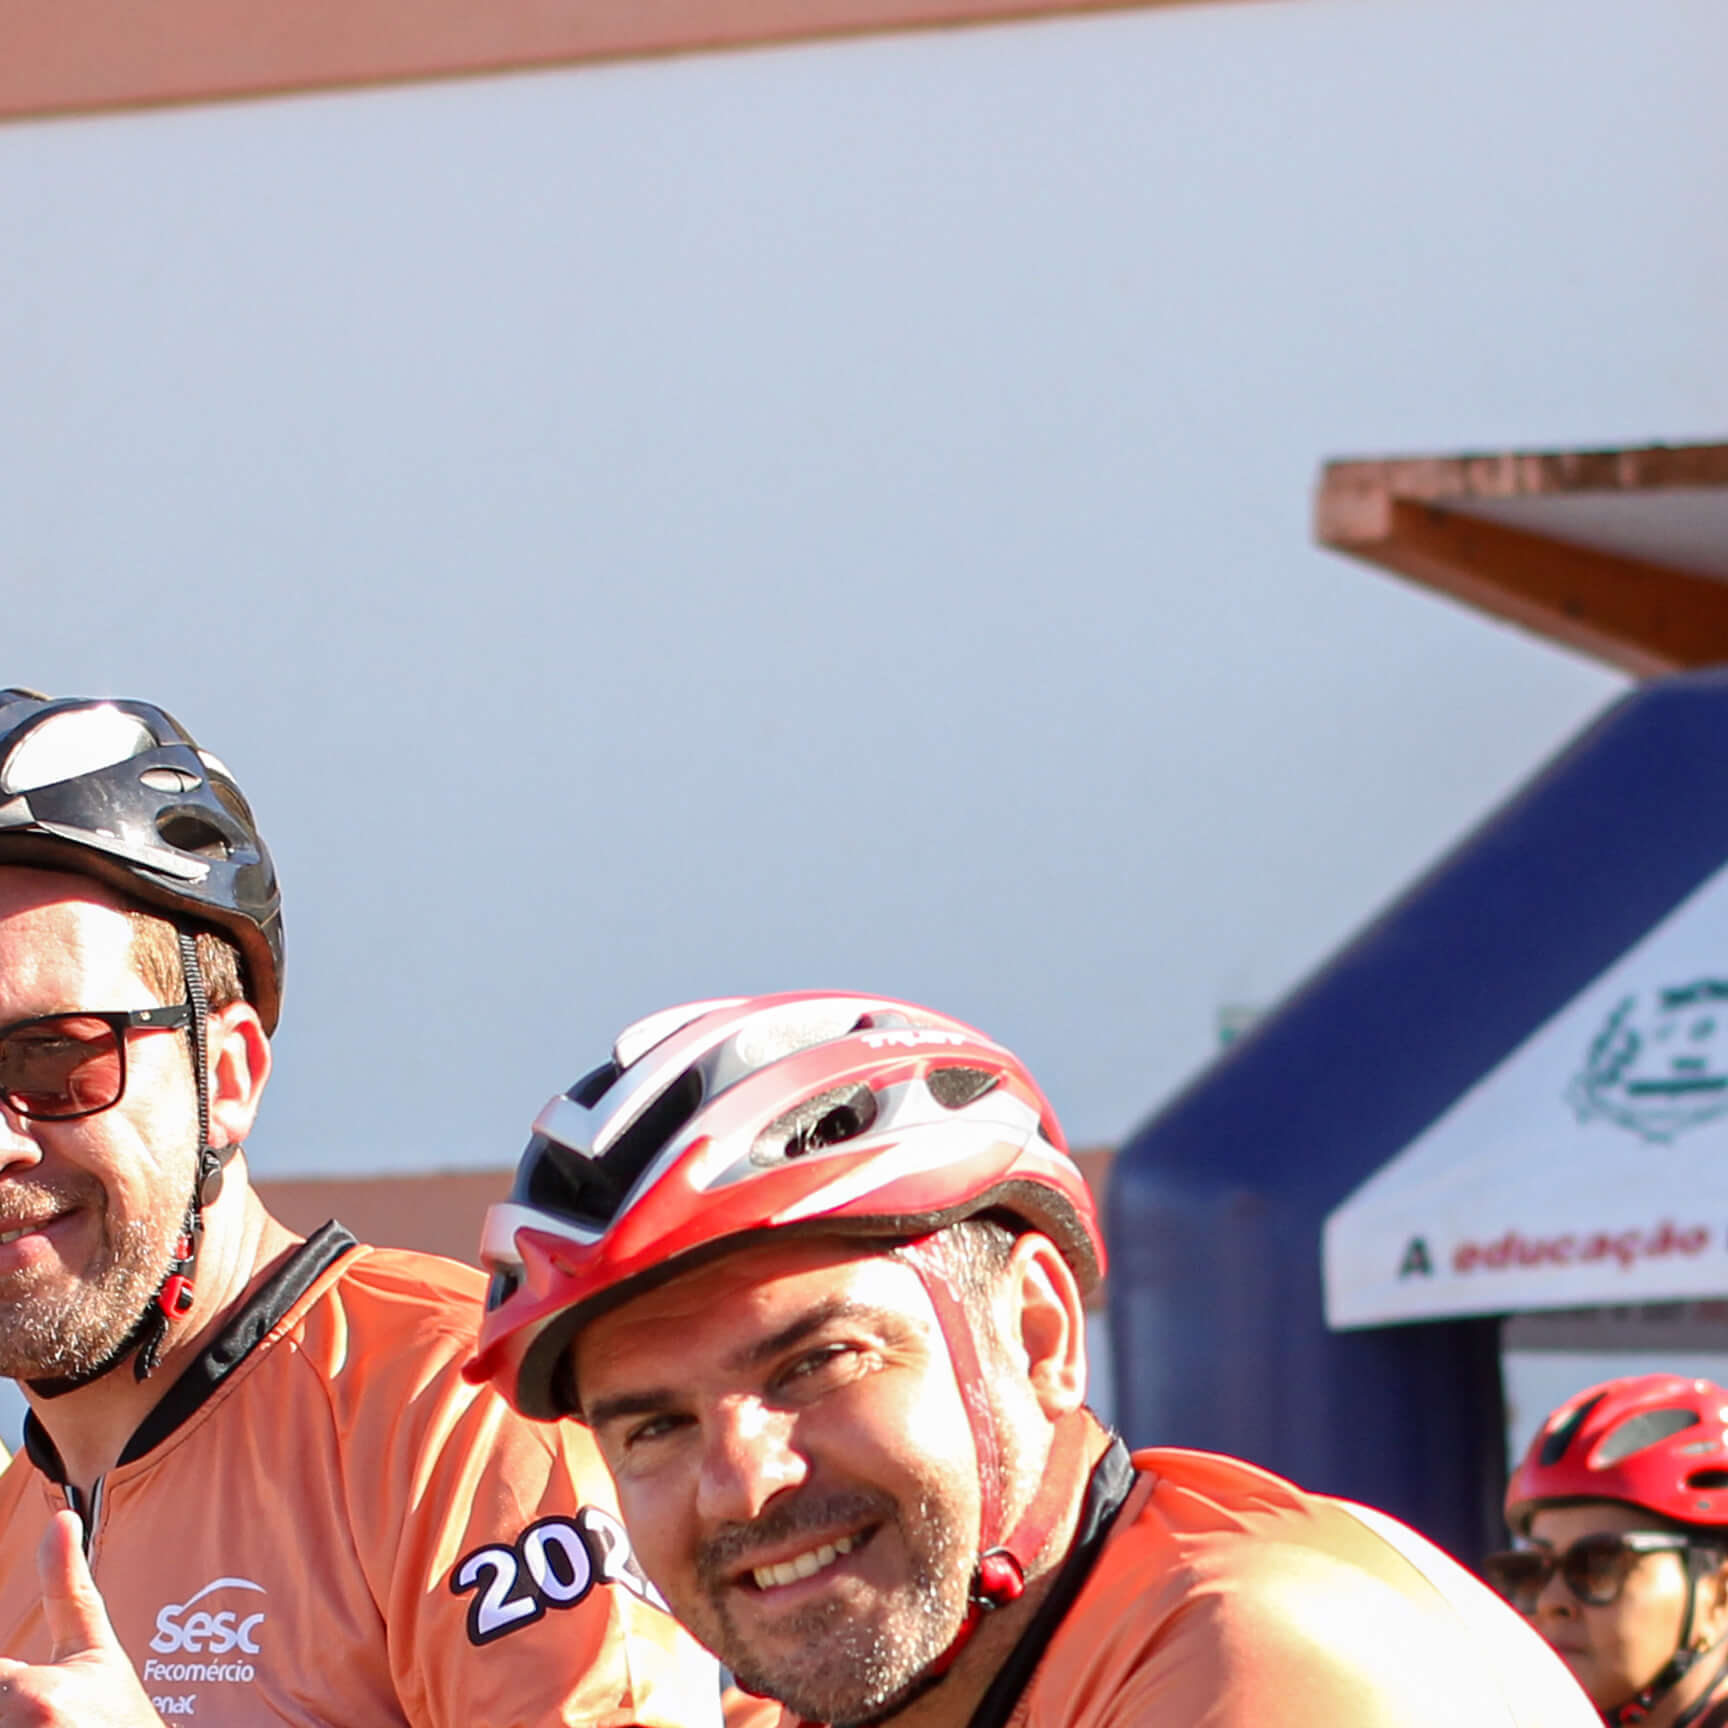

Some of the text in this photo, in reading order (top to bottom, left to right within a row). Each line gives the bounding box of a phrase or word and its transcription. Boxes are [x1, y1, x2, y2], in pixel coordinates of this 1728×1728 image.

[1398, 1237, 1434, 1280] A
[1452, 1222, 1710, 1277] educação
[456, 1506, 671, 1638] 202
[149, 1602, 266, 1654] Sesc
[143, 1658, 256, 1682] Fecomércio
[152, 1694, 198, 1715] enac
